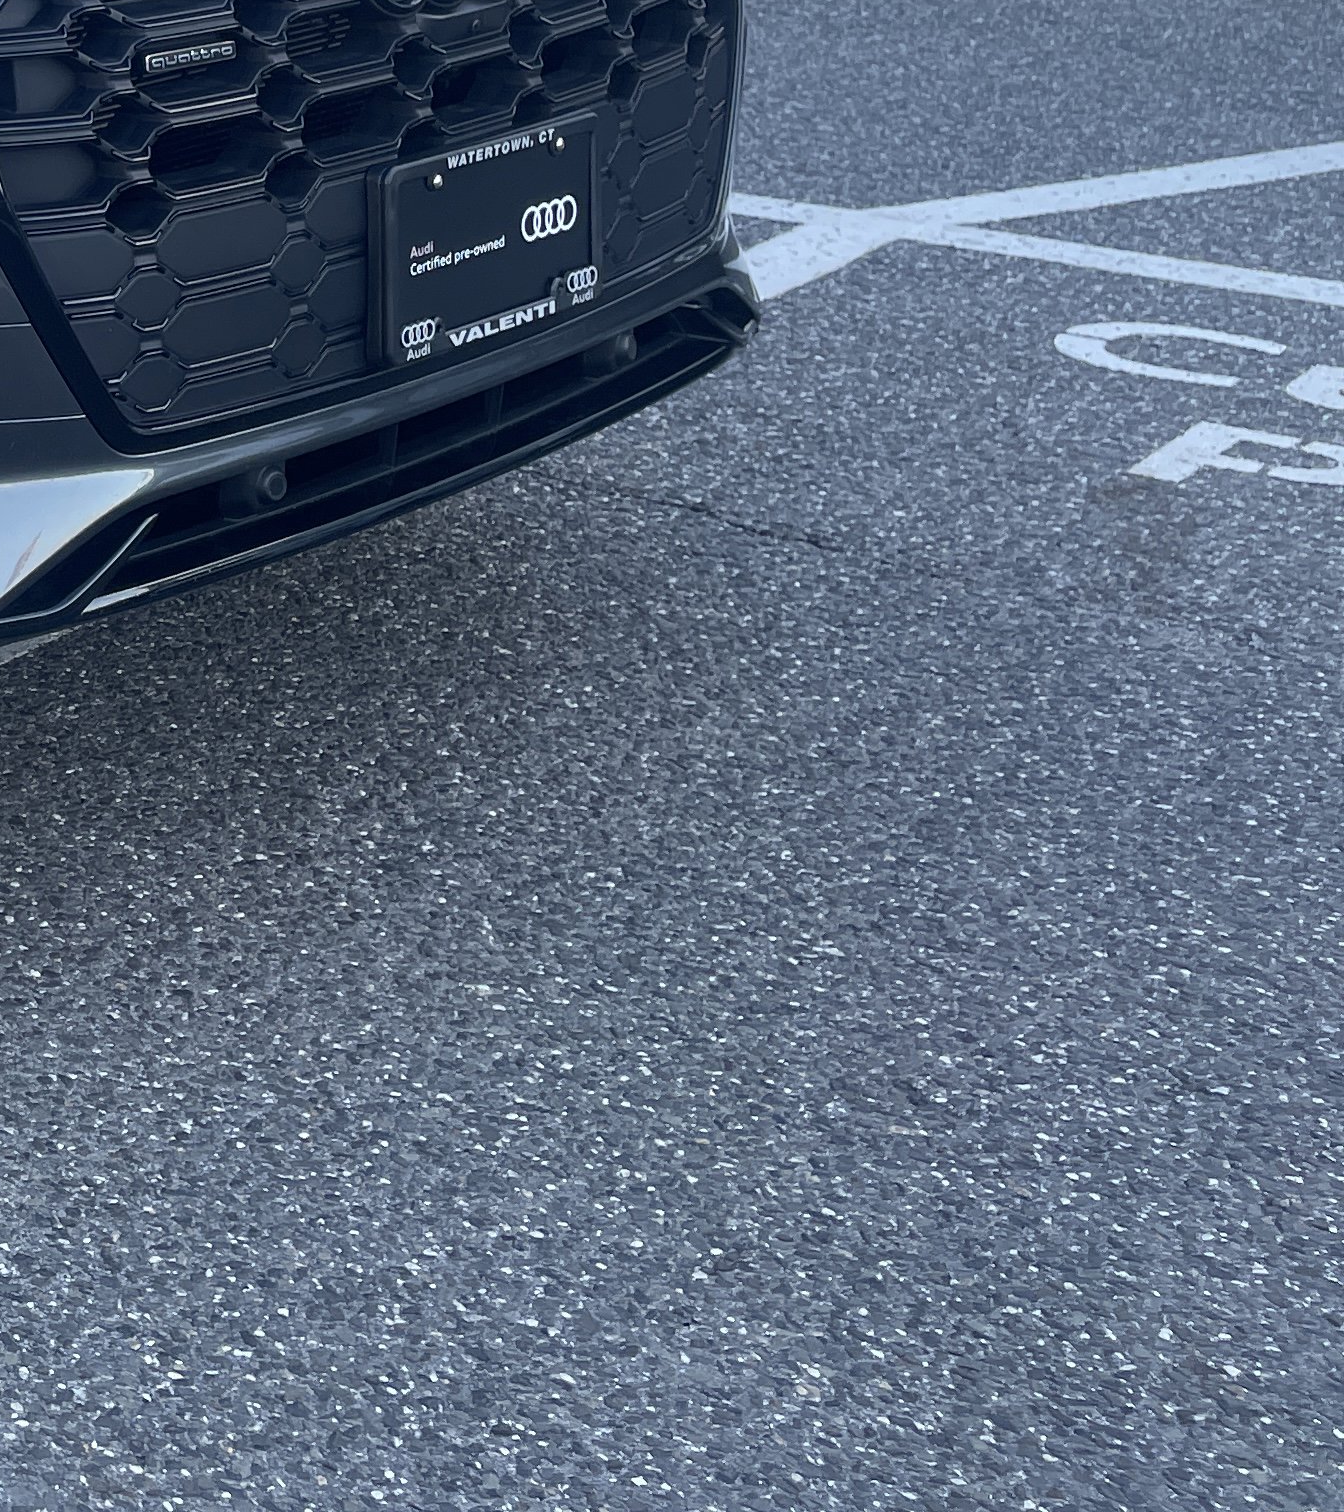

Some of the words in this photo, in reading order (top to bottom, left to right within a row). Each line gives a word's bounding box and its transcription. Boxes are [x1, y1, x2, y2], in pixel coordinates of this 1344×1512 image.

[151, 45, 233, 70] quattro
[447, 135, 534, 170] WATERTOWN,
[538, 128, 555, 144] CT
[410, 240, 434, 259] Audi
[410, 251, 452, 276] Certified
[454, 234, 506, 265] pre-owned
[572, 289, 594, 305] Audi
[449, 300, 556, 347] VALENTI
[406, 343, 431, 362] Audi
